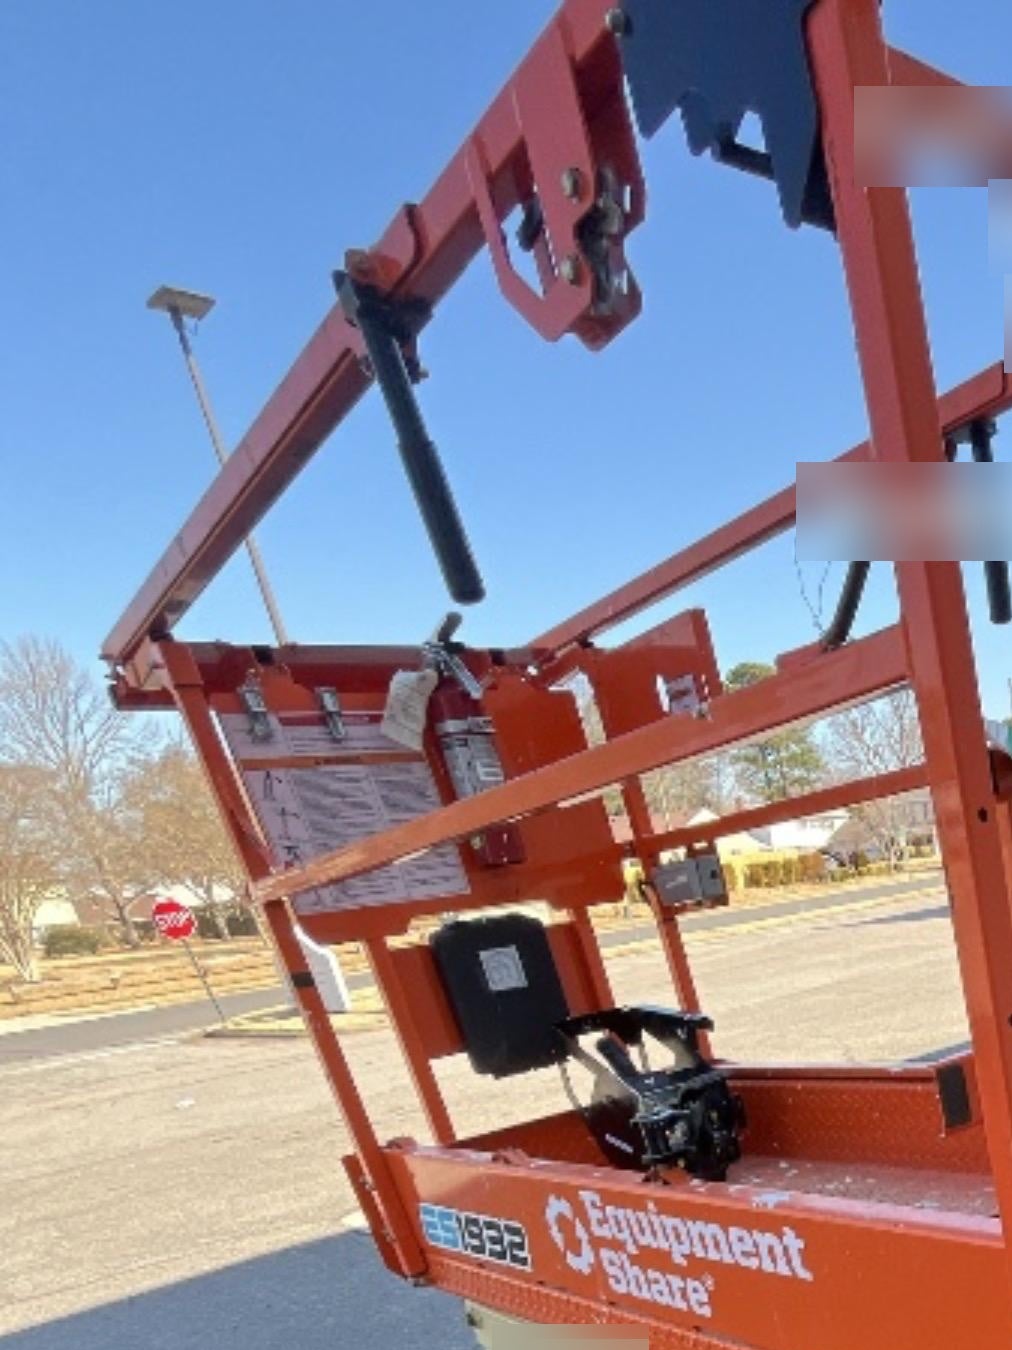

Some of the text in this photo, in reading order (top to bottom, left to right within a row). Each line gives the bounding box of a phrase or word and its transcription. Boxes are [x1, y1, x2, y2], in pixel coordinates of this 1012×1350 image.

[154, 906, 190, 929] STOP
[419, 1202, 532, 1272] ES1932
[579, 1190, 813, 1281] Equipment
